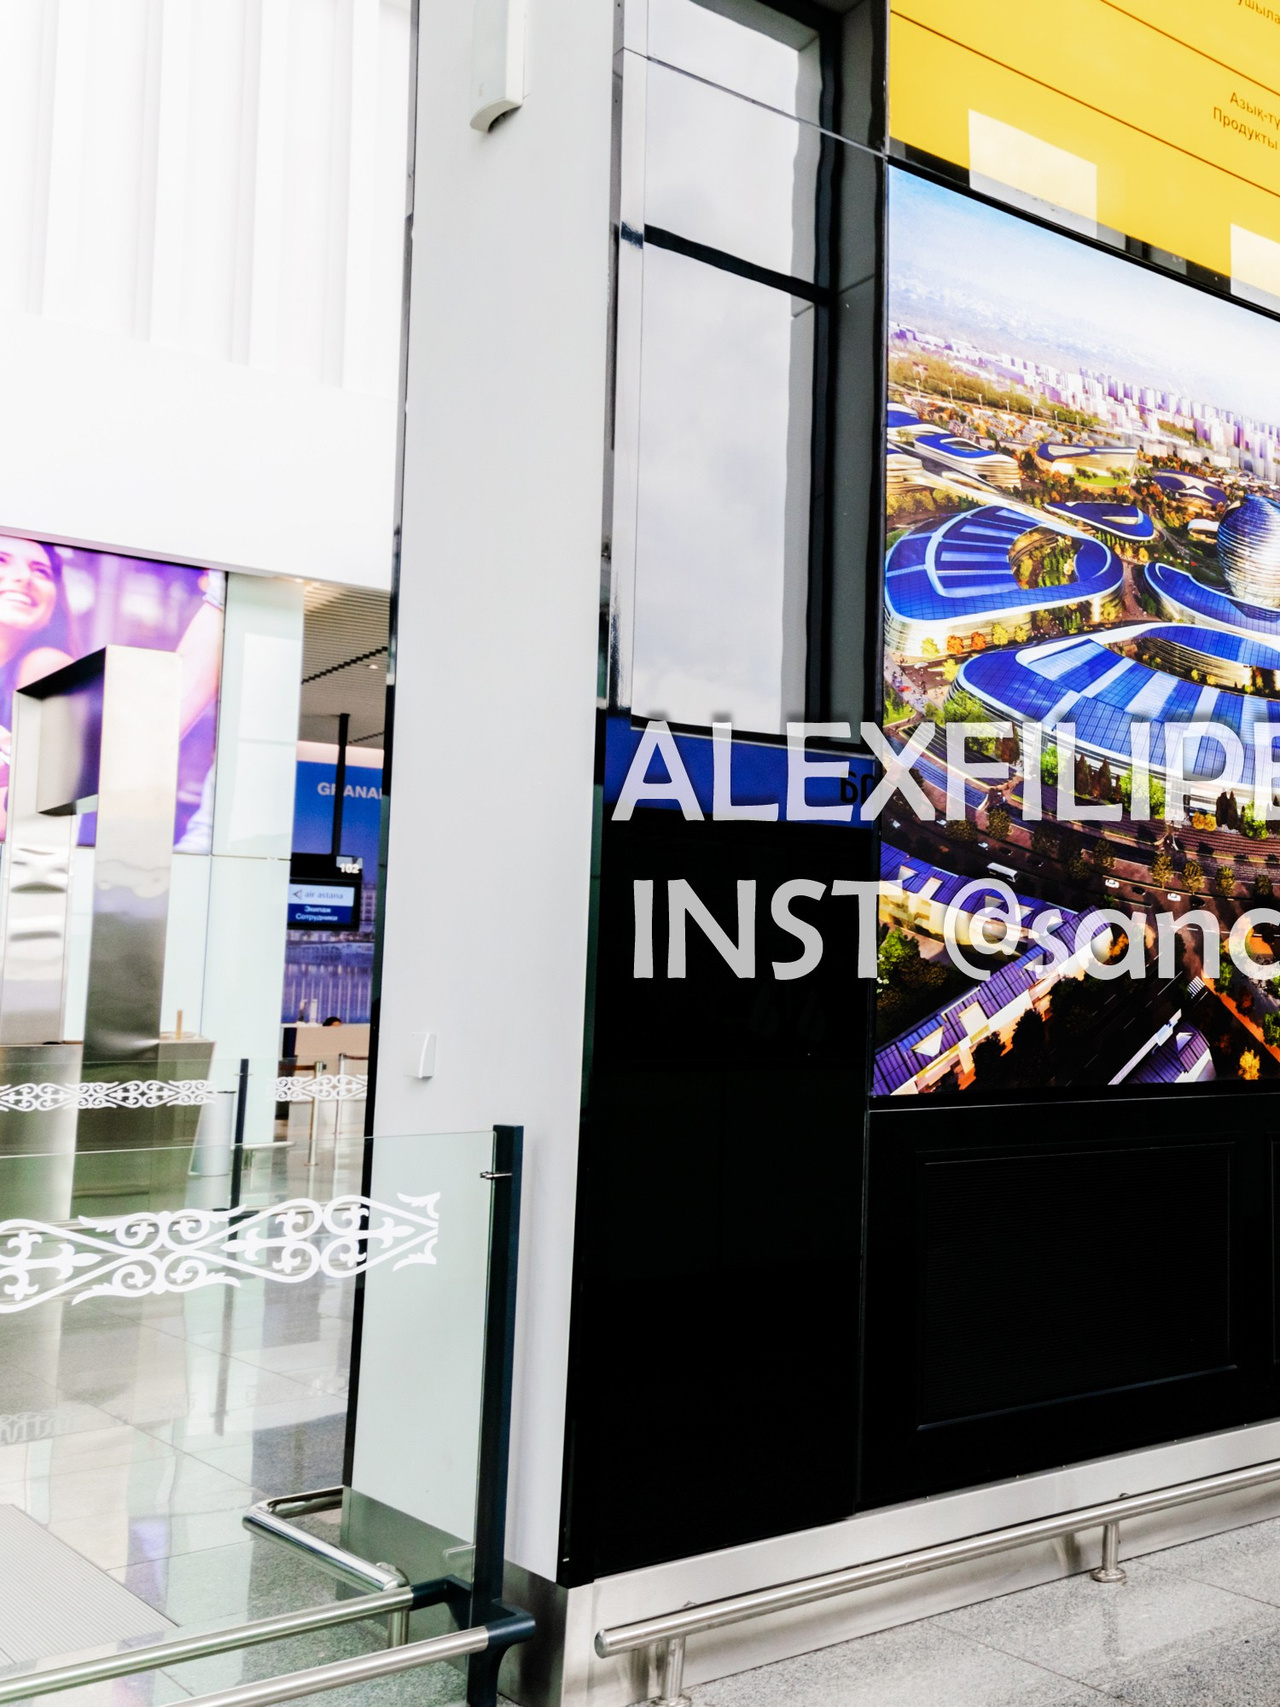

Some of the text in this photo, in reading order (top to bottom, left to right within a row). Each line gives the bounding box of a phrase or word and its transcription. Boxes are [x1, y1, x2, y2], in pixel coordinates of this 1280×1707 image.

[1213, 106, 1278, 150] Продукты
[317, 782, 382, 800] GANA
[339, 862, 360, 874] 102
[317, 891, 344, 899] astana
